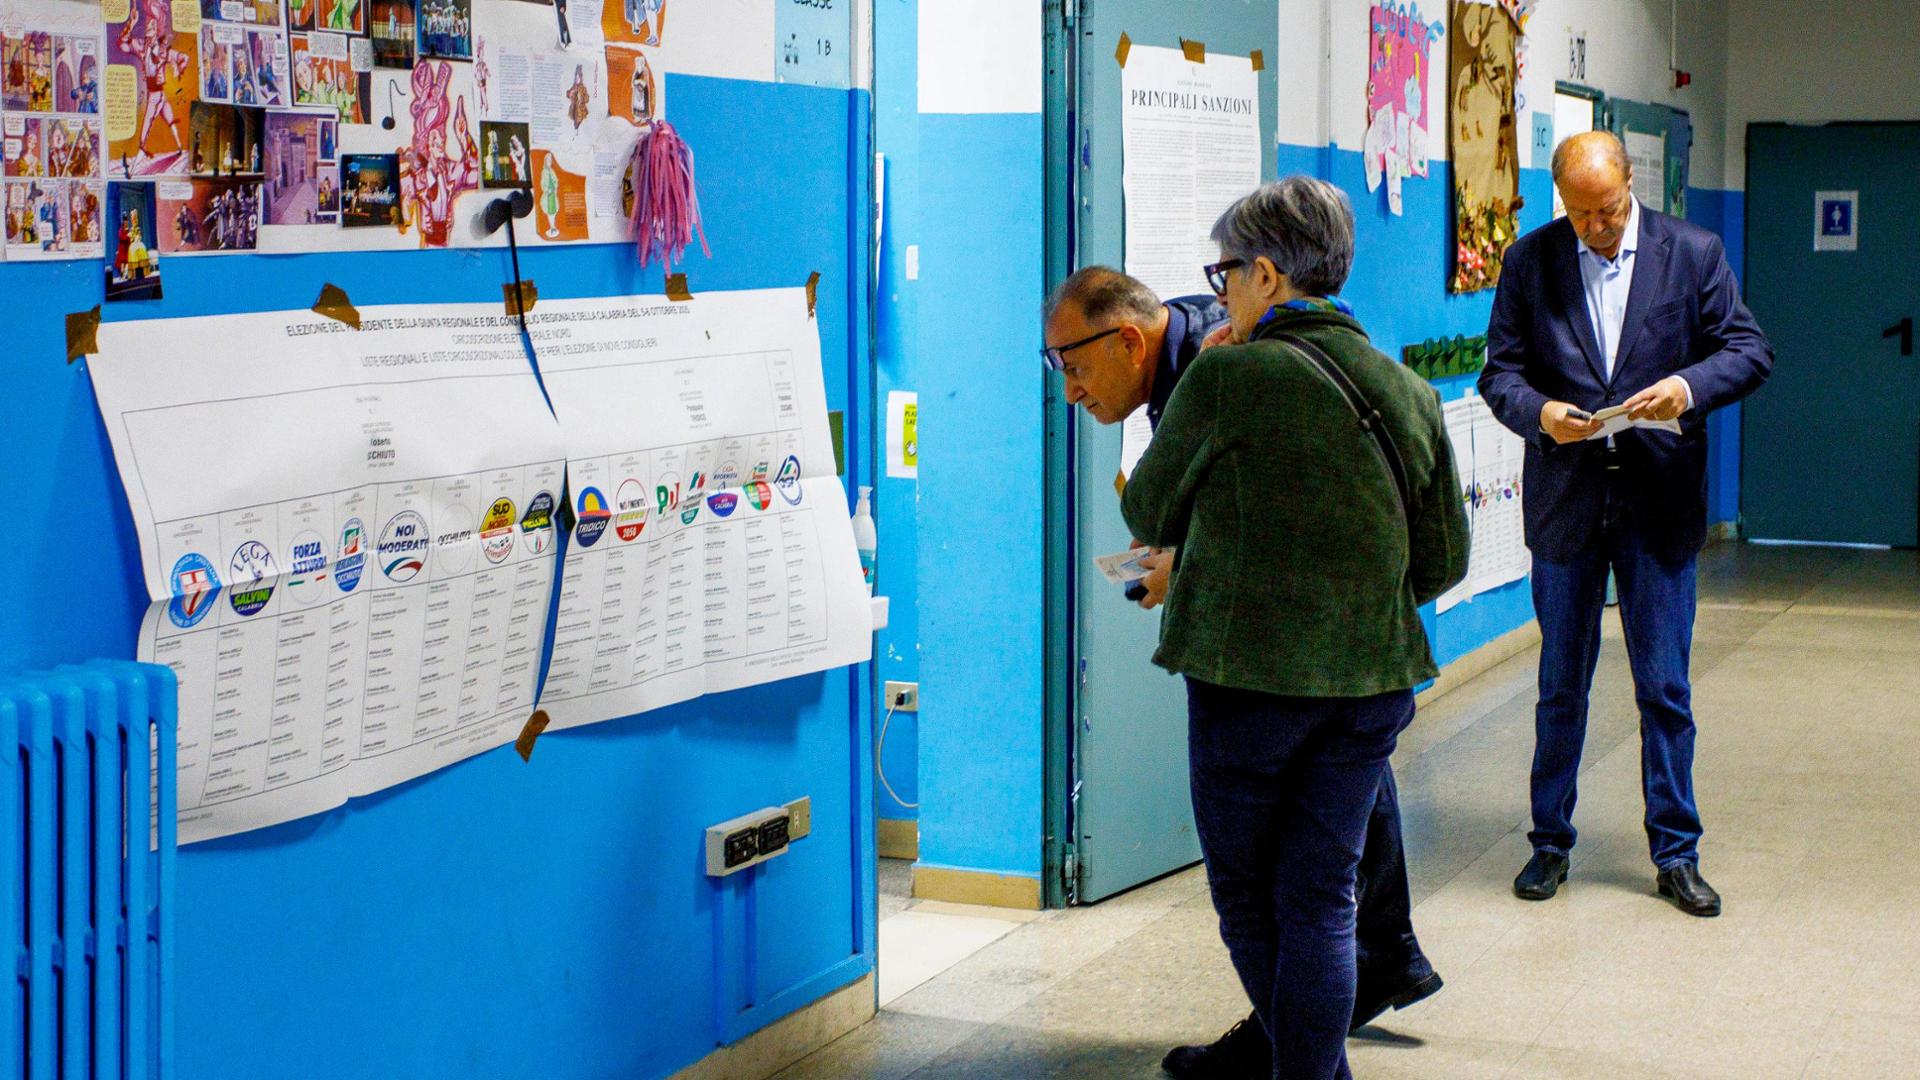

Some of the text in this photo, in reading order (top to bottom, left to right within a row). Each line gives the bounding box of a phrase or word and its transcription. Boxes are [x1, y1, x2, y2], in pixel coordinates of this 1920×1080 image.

[1131, 89, 1252, 115] PRINCIPALI SANZIONI
[286, 322, 329, 337] ELEZIONE
[328, 322, 346, 334] DEL
[394, 317, 418, 329] DELLA
[442, 317, 479, 328] REGIONALE
[486, 317, 499, 327] DEL
[539, 311, 577, 325] REGIONALE
[576, 311, 597, 321] DELLA
[597, 308, 627, 321] CALABRIA
[627, 308, 641, 318] DEL
[650, 305, 677, 316] OTTOBRE
[551, 327, 572, 340] NORD
[493, 502, 510, 516] SUD
[395, 524, 416, 538] NOI
[578, 520, 606, 534] TRIDICO
[233, 542, 271, 573] LEGA
[294, 541, 321, 559] FORZA
[291, 556, 327, 576] AZZURRI
[233, 588, 270, 606] SALVINI
